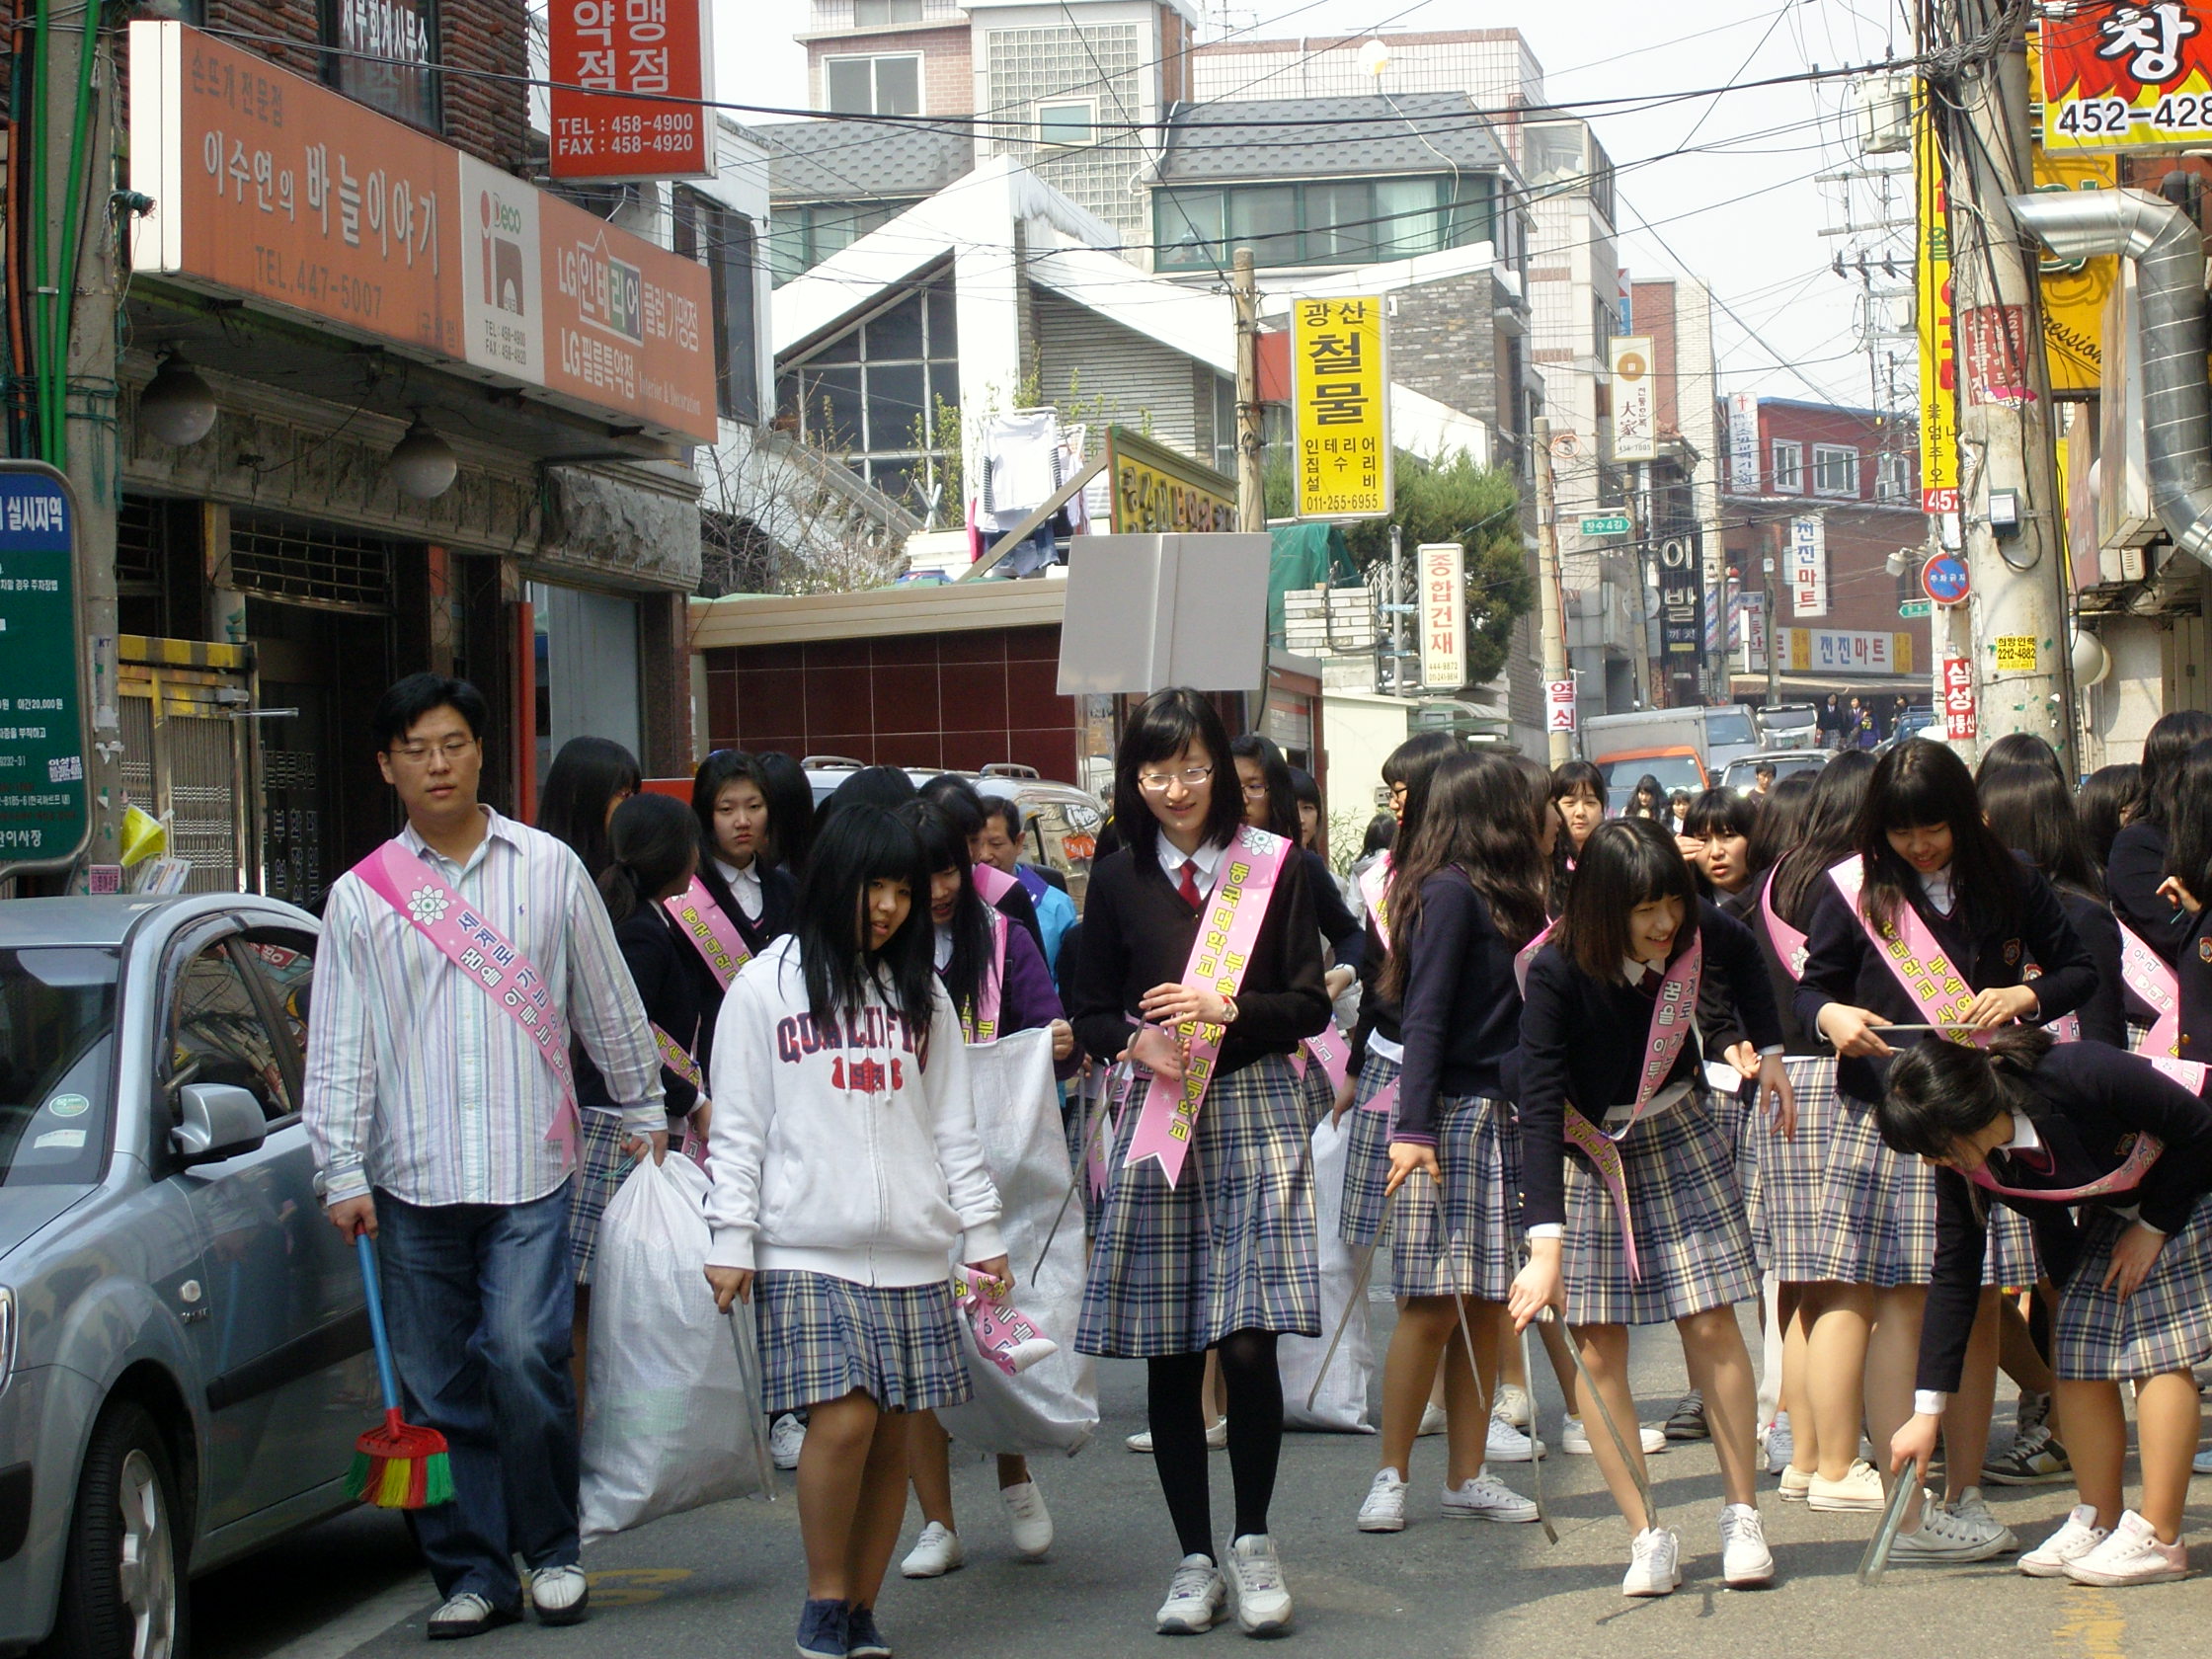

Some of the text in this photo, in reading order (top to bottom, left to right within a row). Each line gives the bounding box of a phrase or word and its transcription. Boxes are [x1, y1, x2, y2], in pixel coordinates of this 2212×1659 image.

[2099, 3, 2196, 80] 창
[241, 72, 283, 127] 전문점
[558, 118, 593, 134] TEL
[611, 114, 693, 132] 458-4900
[559, 138, 593, 155] FAX
[611, 134, 693, 153] 458-4920
[203, 130, 294, 223] 이수연의
[1304, 301, 1367, 327] 광산
[1308, 332, 1369, 426] 철물
[1305, 436, 1375, 454] 인테리어
[7, 496, 64, 532] 실시지역
[1306, 494, 1379, 511] 011-255-6955
[1427, 553, 1455, 655] 종합건재
[1661, 534, 1698, 622] 이발
[1550, 681, 1575, 730] 열쇠
[1947, 662, 1972, 710] 삼성
[1947, 713, 1975, 735] 부동산
[1194, 860, 1251, 979] 동국대학교
[457, 910, 515, 968] 세계로
[515, 966, 550, 1009] 가는
[459, 946, 505, 988] 꿈을
[503, 986, 553, 1047] 이루는
[1200, 951, 1247, 1049] 부속자
[1658, 980, 1683, 1026] 꿈을
[1168, 1057, 1213, 1142] 고등학교
